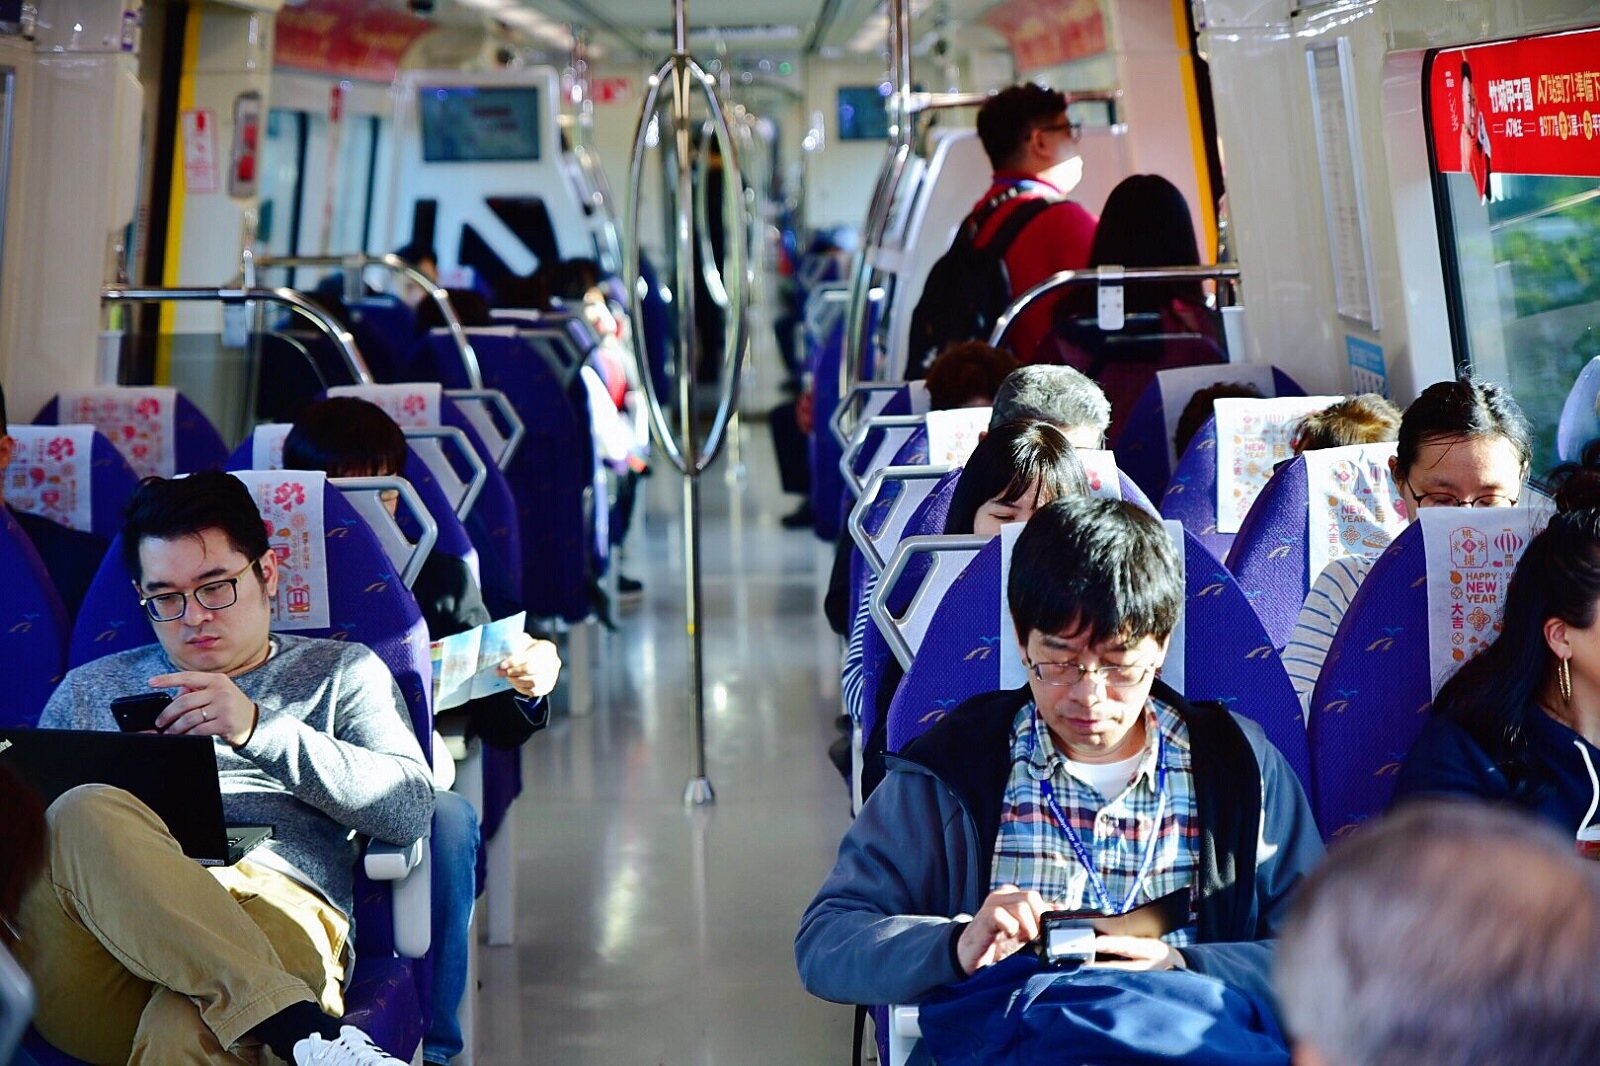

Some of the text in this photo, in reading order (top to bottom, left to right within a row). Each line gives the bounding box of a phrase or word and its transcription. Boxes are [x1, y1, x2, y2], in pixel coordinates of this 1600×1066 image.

[1341, 505, 1366, 514] NEW
[1341, 515, 1367, 523] YEAR
[1328, 522, 1339, 544] 大吉
[1466, 572, 1497, 581] HAPPY
[1466, 581, 1497, 593] NEW
[1466, 594, 1497, 604] YEAR
[1451, 602, 1464, 630] 大吉
